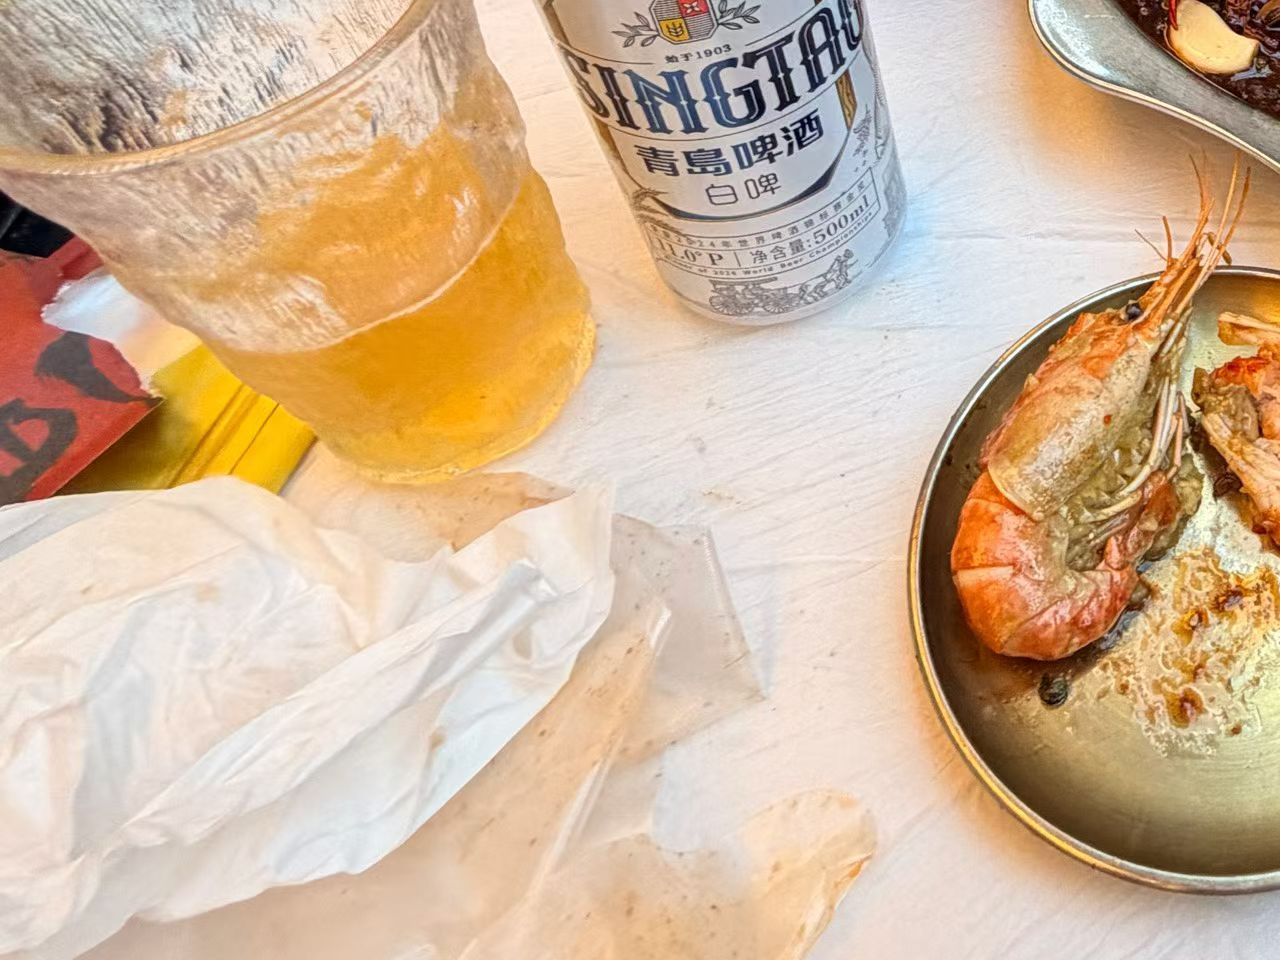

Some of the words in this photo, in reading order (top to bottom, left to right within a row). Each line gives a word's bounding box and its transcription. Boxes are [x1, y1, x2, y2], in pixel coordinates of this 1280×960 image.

[634, 107, 824, 177] 青島啤酒
[705, 172, 782, 206] 白啤
[742, 266, 775, 276] World
[780, 258, 804, 270] Beer
[809, 210, 873, 258] Championships
